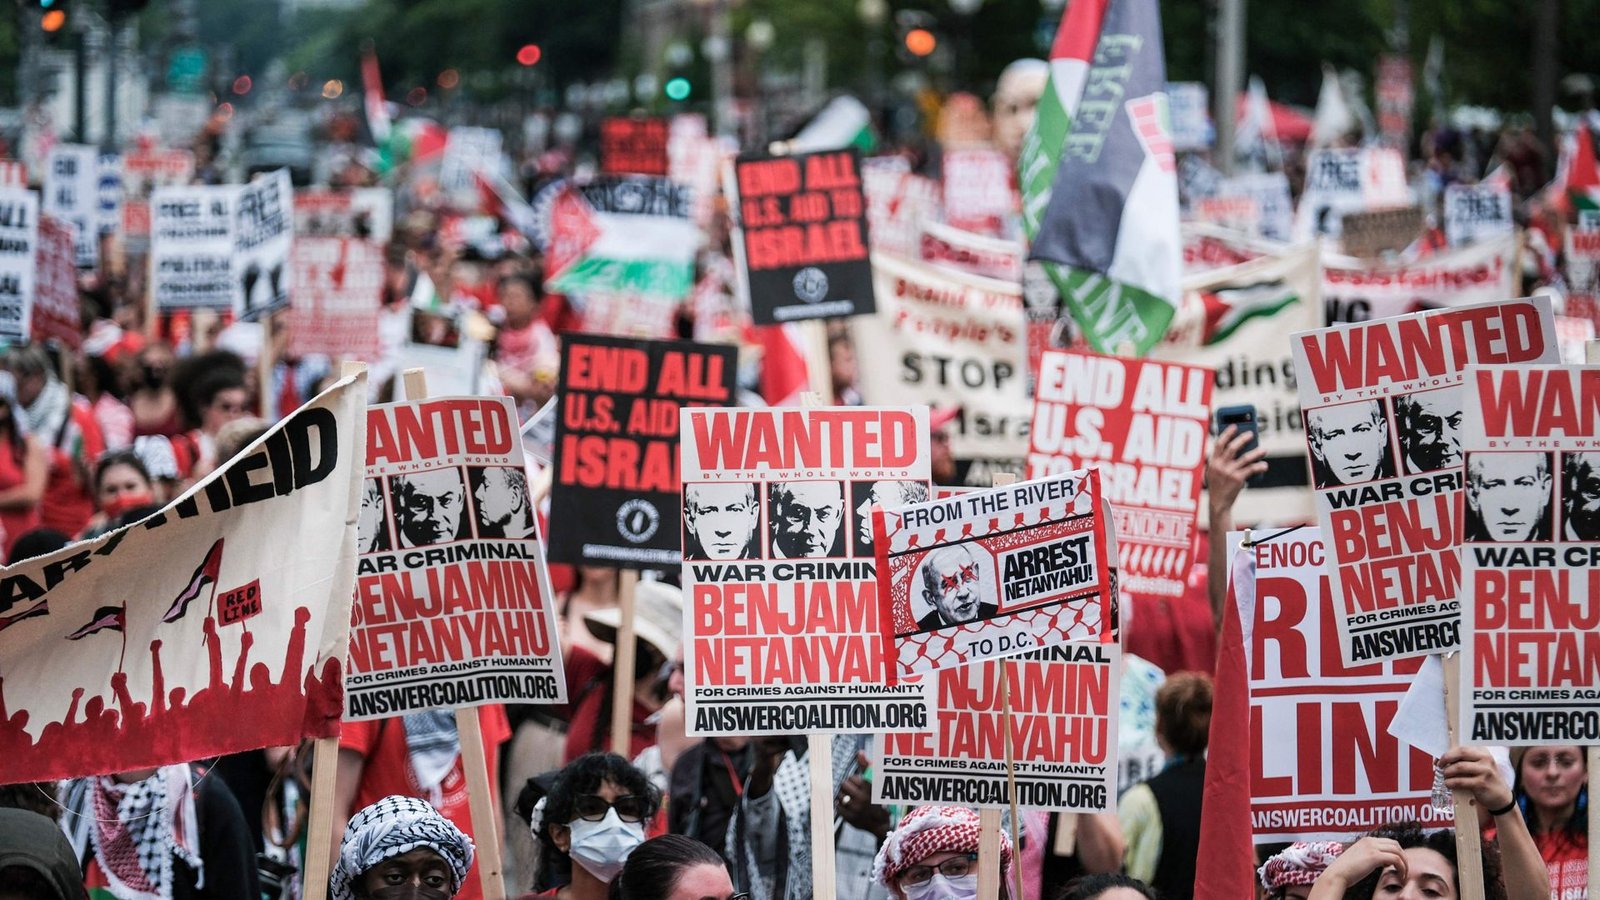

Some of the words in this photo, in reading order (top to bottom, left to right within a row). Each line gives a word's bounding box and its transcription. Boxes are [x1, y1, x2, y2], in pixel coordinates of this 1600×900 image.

[738, 159, 800, 197] END
[806, 152, 861, 190] ALL
[790, 191, 829, 222] AID
[830, 188, 863, 218] TO
[746, 220, 867, 270] ISRAEL
[1301, 303, 1544, 394] WANTED
[566, 344, 650, 394] END
[656, 351, 729, 401] ALL
[901, 350, 1014, 390] STOP
[1038, 351, 1126, 409] END
[1131, 362, 1209, 421] ALL
[1323, 394, 1342, 403] BY
[1357, 387, 1390, 398] THE
[1403, 374, 1463, 391] WHOLE
[563, 392, 621, 432] U.S.
[627, 398, 680, 436] AID
[691, 410, 918, 470] WANTED
[1032, 401, 1114, 460] U.S.
[1121, 412, 1204, 470] AID
[398, 457, 454, 471] WHOLE
[560, 433, 682, 492] ISRA
[1080, 455, 1197, 512] SRAEL
[1326, 481, 1404, 509] WAR
[903, 501, 963, 529] FROM
[968, 492, 1009, 517] THE
[1014, 478, 1074, 504] RIVER
[403, 543, 535, 569] CRIMINAL
[692, 564, 766, 582] WAR
[1003, 536, 1090, 583] ARREST
[1473, 547, 1556, 567] WAR
[226, 586, 256, 607] RED
[1005, 563, 1093, 601] NETANYAHU!
[224, 600, 258, 622] LINE
[693, 581, 881, 636] BENJAM
[1347, 614, 1377, 626] FOR
[1379, 604, 1436, 621] CRIMES
[346, 611, 550, 675] NETANYAHU
[968, 638, 993, 657] TO
[999, 631, 1033, 650] D.C.
[346, 676, 374, 686] FOR
[374, 667, 428, 682] CRIMES
[430, 658, 489, 673] AGAINST
[491, 657, 553, 667] HUMANITY
[695, 688, 723, 697] FOR
[726, 686, 782, 696] CRIMES
[784, 685, 846, 695] AGAINST
[848, 684, 924, 694] HUMANITY
[348, 675, 558, 718] ANSWERCOALITION.ORG
[1473, 690, 1505, 700] FOR
[1509, 690, 1570, 700] CRIMES
[694, 702, 927, 732] ANSWERCOALITION.ORG
[883, 757, 912, 768] FOR
[914, 759, 967, 769] CRIMES
[1031, 763, 1106, 775] HUMANITY
[1250, 700, 1434, 798] LIN
